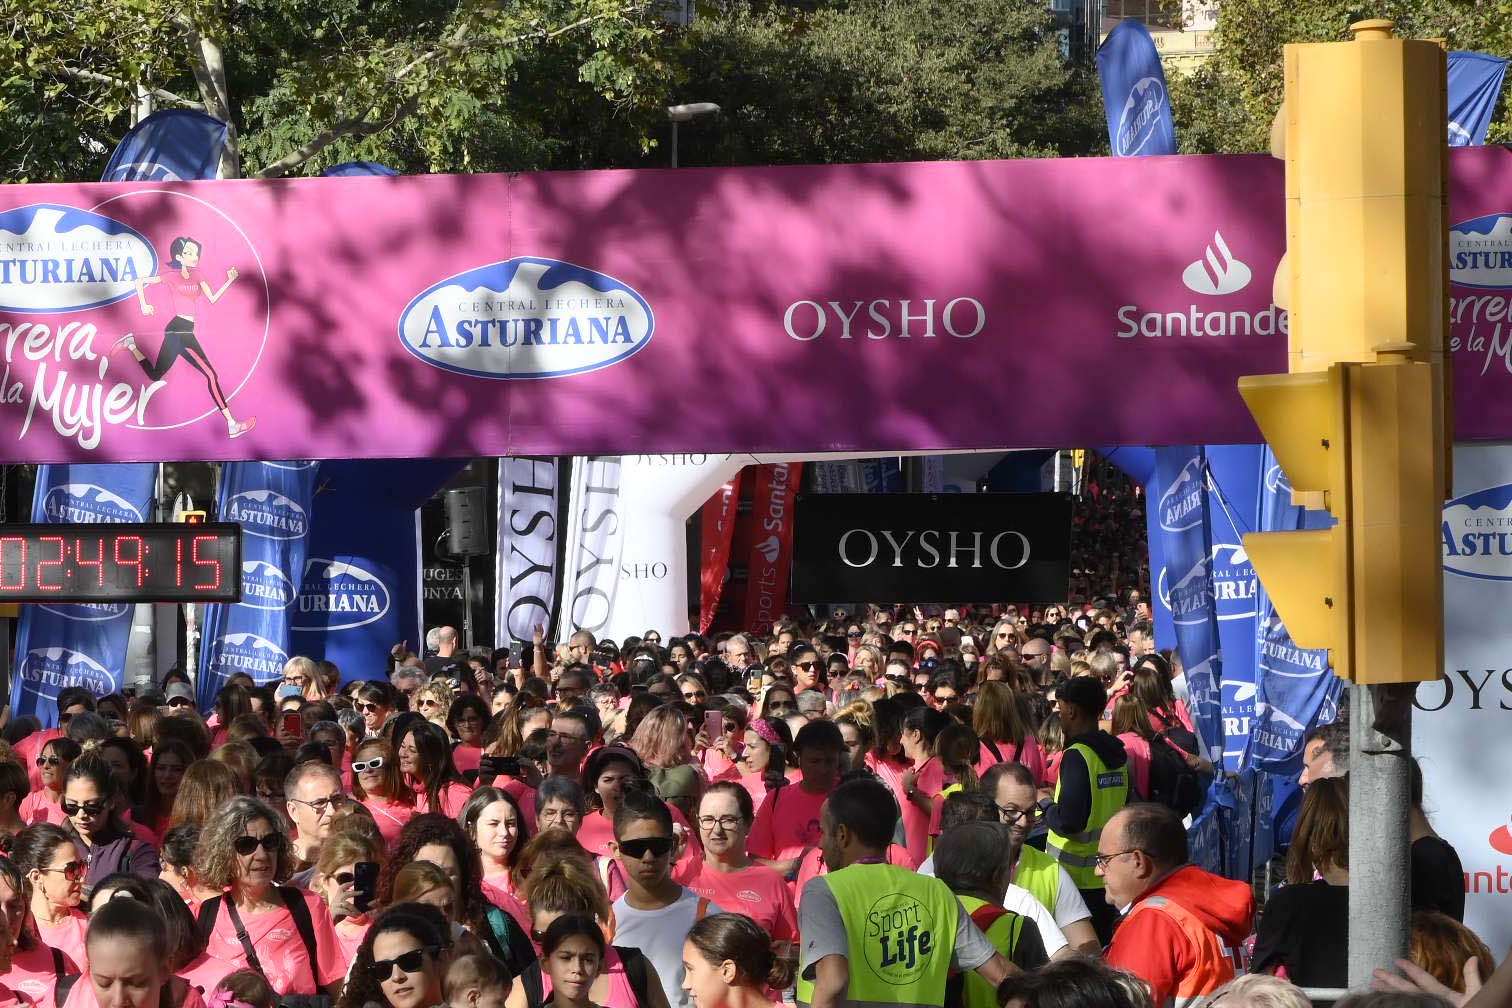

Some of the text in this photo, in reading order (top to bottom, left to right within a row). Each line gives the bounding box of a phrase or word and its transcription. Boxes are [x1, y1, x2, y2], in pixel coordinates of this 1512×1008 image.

[61, 239, 134, 252] LECHERA
[1449, 251, 1512, 270] STUR
[458, 297, 643, 313] CENTRAL LECHERA
[784, 297, 986, 342] OYSHO
[1117, 304, 1288, 339] Santande
[418, 305, 634, 350] ASTURIANA
[0, 364, 24, 404] la
[19, 356, 167, 450] Mujer
[230, 501, 304, 534] ASTURIANA
[763, 462, 789, 532] Santa
[0, 536, 220, 590] 02:49:15
[507, 457, 556, 643] OYSH
[839, 529, 1031, 570] OYSHO
[1261, 640, 1322, 670] TURIANA
[869, 901, 921, 937] Sport
[880, 925, 931, 969] Life
